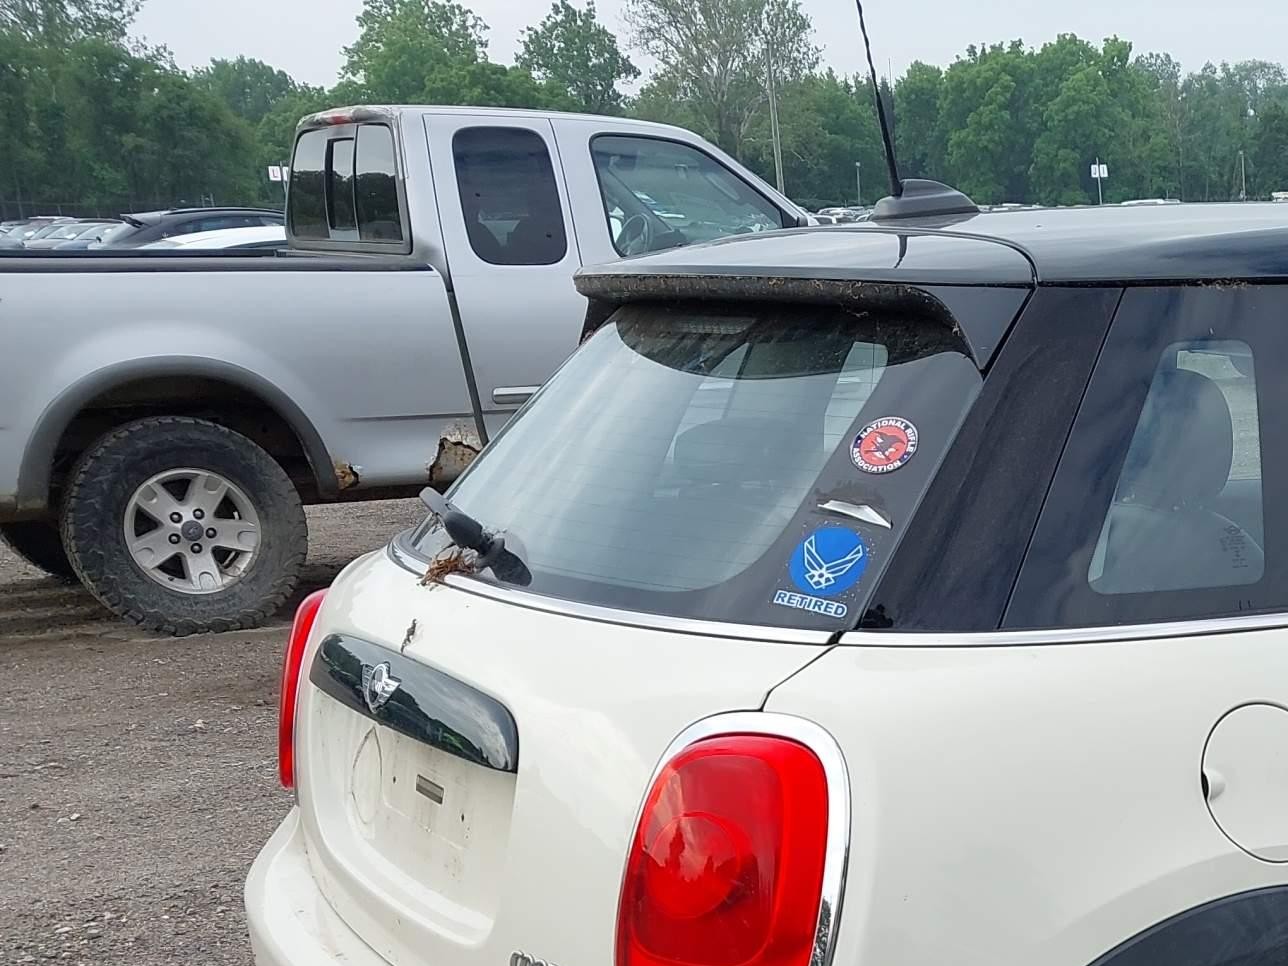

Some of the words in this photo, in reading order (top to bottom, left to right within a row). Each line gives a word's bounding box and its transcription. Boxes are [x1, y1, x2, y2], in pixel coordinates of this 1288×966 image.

[860, 419, 906, 438] NATIONAL
[905, 427, 916, 453] RIFLE
[853, 447, 902, 473] ASSOCIATION
[774, 590, 848, 617] RETIRED
